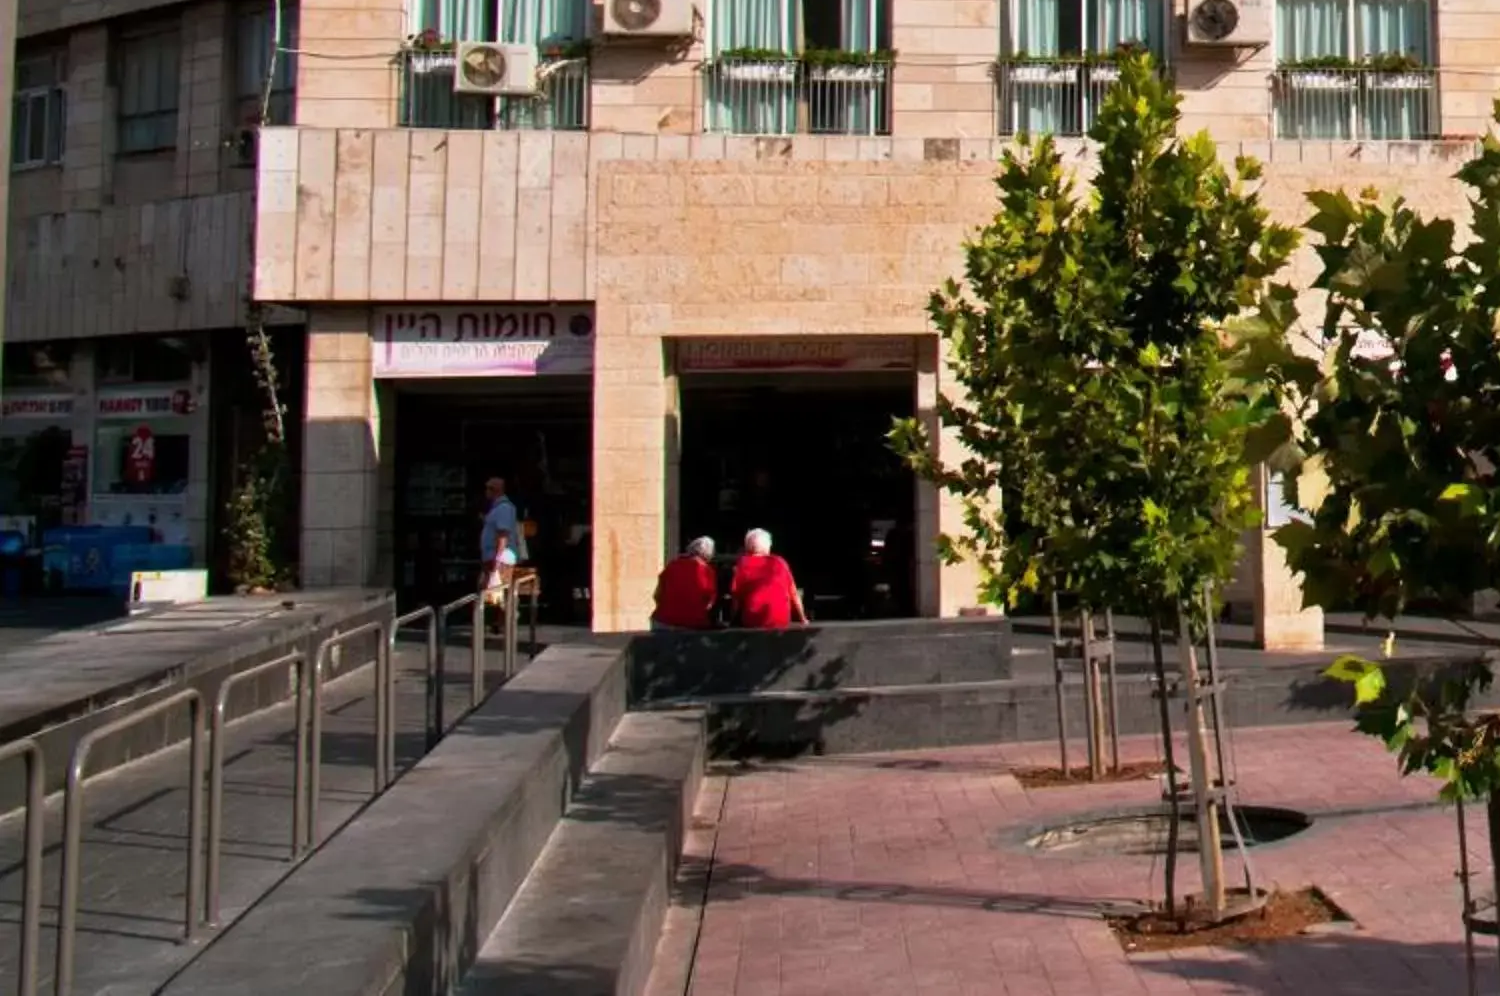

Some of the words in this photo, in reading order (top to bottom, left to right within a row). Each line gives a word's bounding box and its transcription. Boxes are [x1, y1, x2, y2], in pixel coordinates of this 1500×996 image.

[384, 312, 442, 367] היין
[452, 311, 557, 342] חומות
[131, 438, 155, 460] 24
